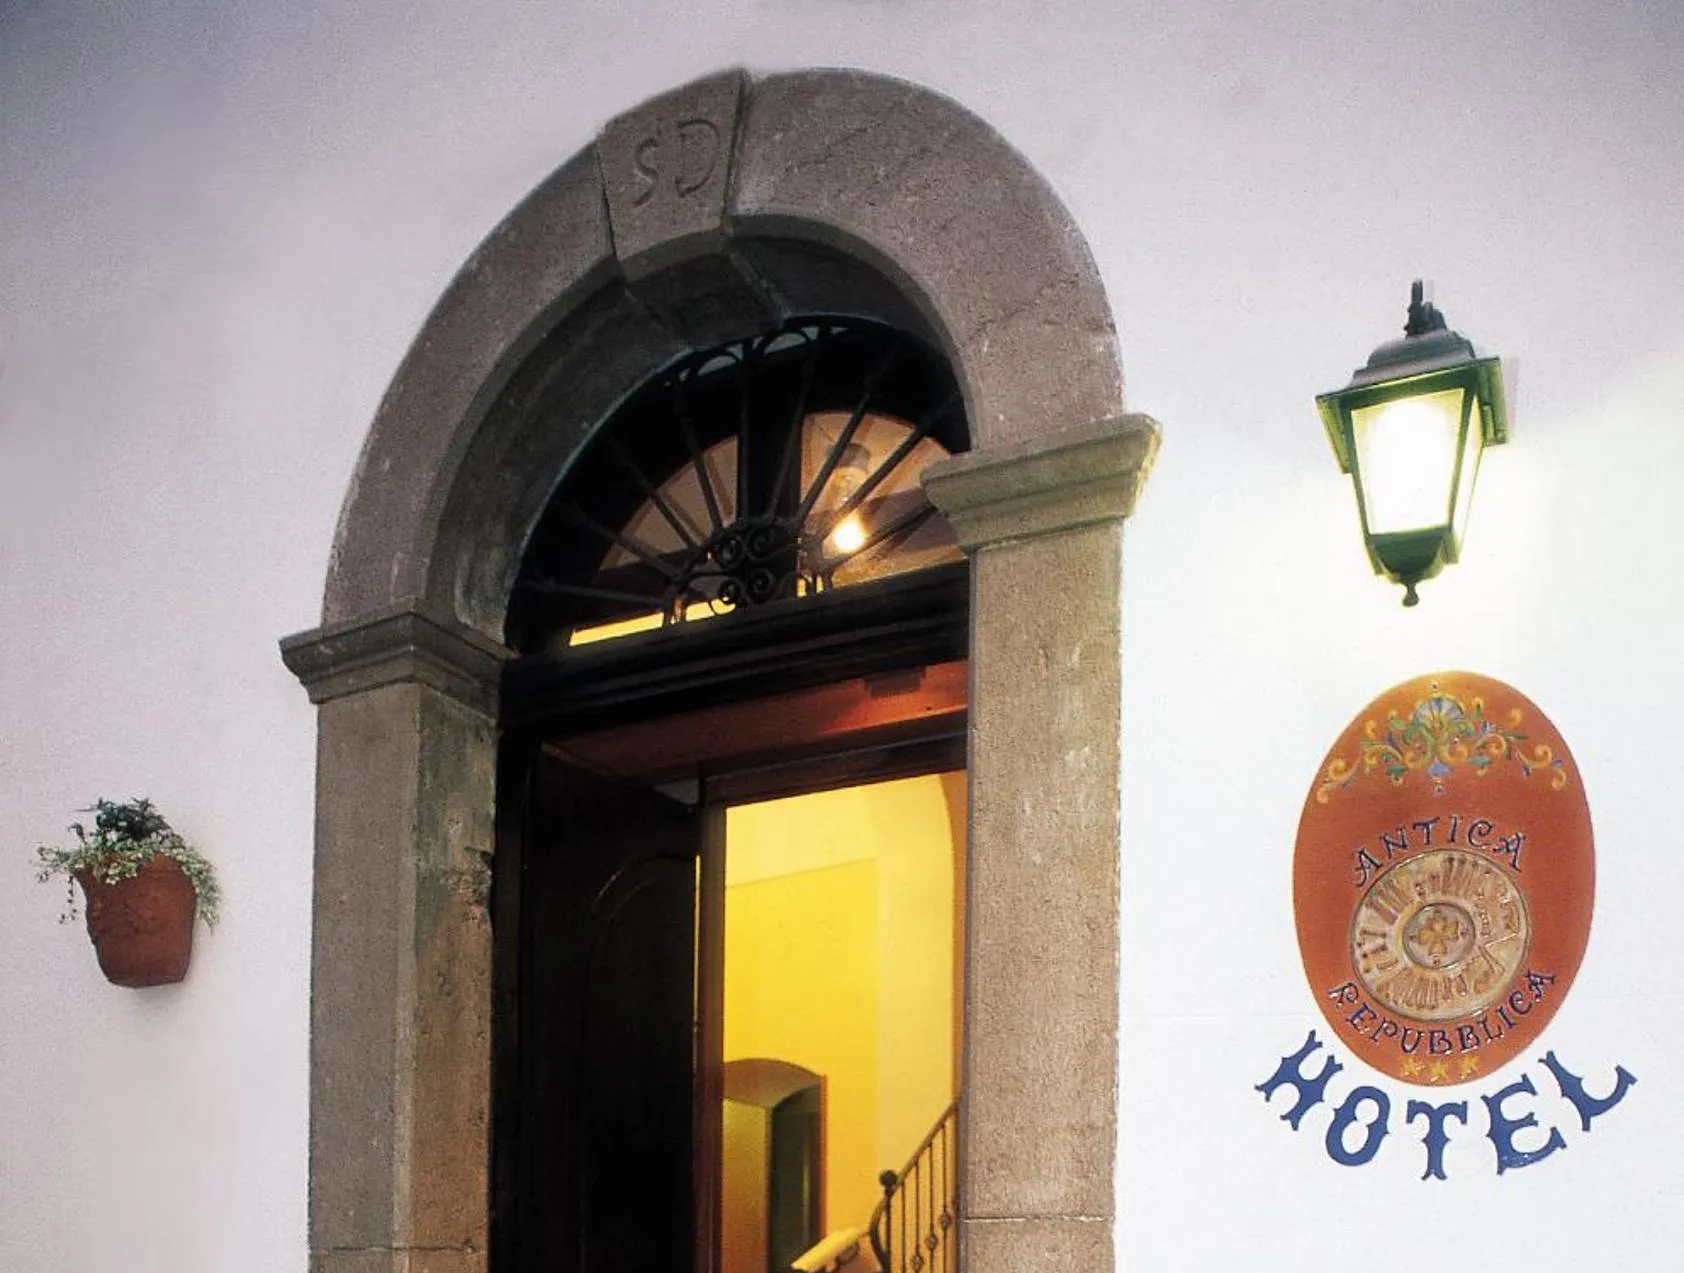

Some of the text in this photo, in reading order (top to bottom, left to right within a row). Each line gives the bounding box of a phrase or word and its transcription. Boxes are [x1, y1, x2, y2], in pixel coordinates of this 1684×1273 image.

[1355, 815, 1528, 888] ANTICA
[1327, 968, 1557, 1057] REPUBBLICA
[1254, 1029, 1638, 1182] HOTEL
